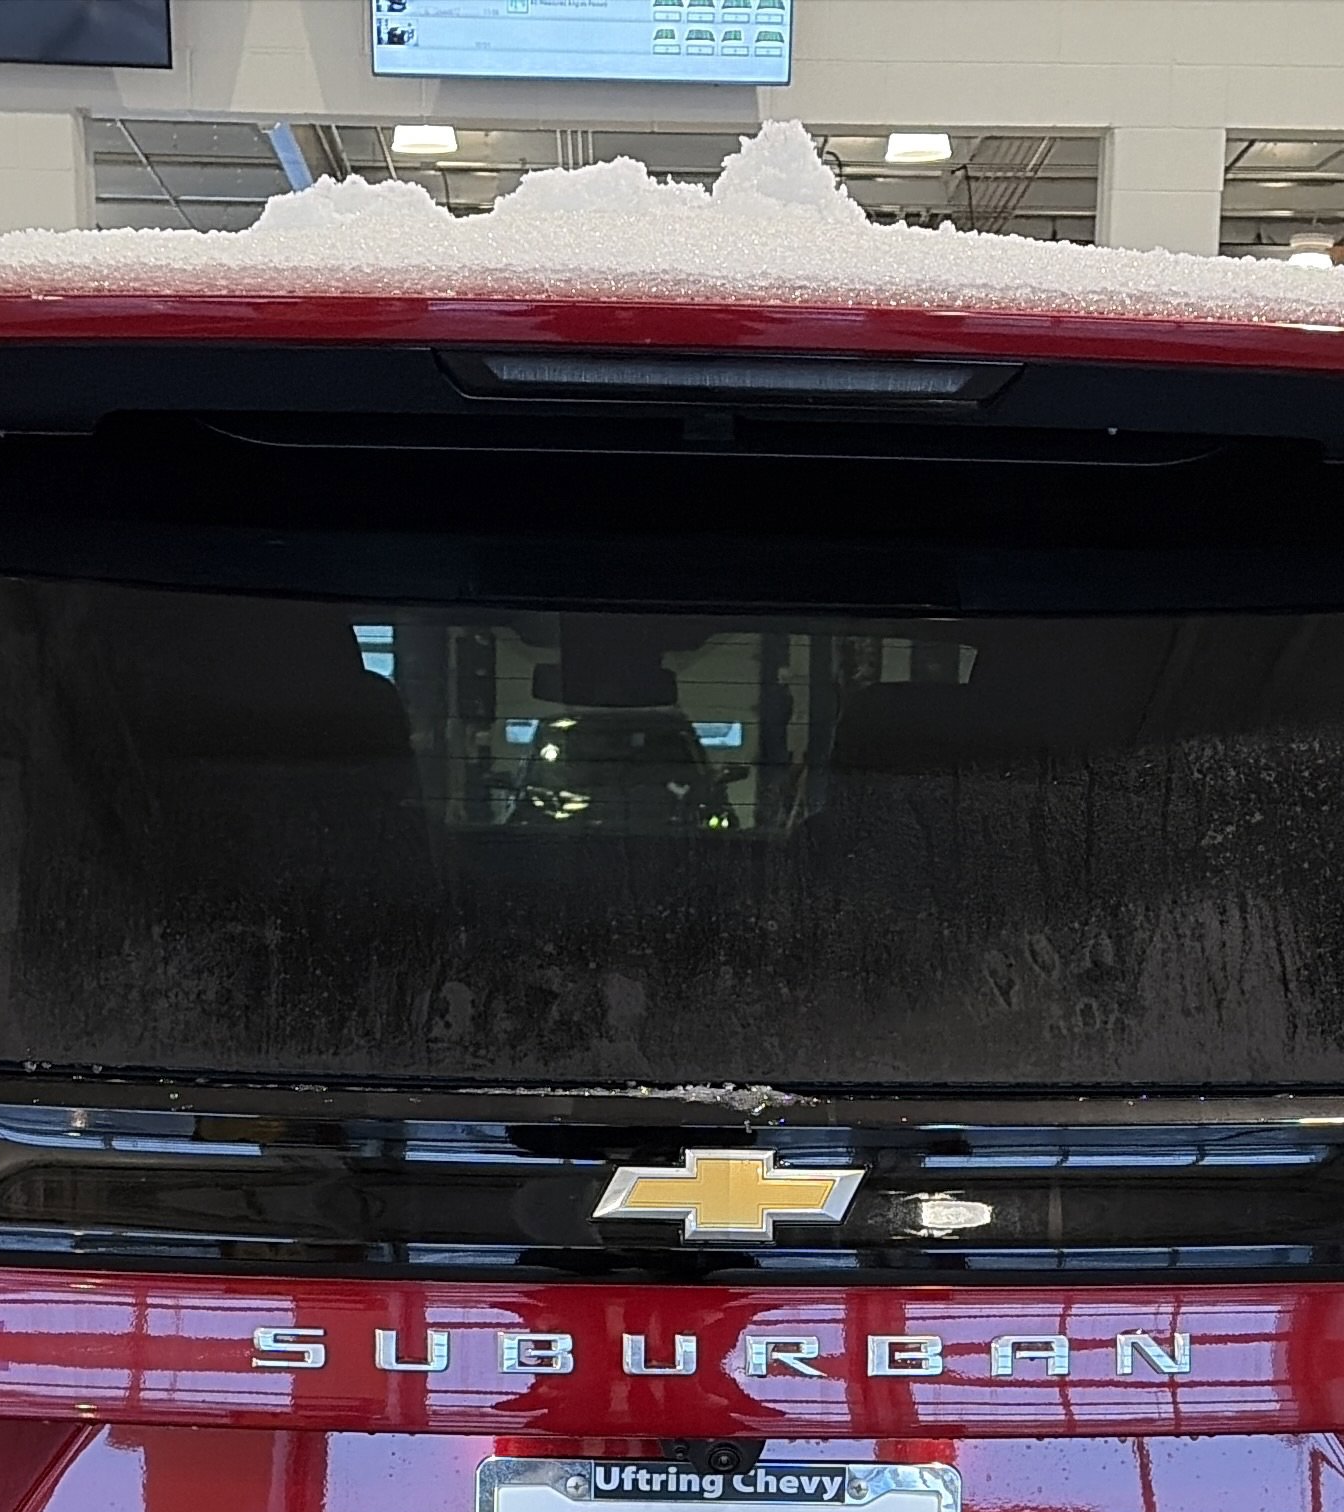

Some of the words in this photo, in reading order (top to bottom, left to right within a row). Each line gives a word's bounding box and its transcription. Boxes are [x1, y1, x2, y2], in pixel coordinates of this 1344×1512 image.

[252, 1326, 1192, 1376] SUBURBAN
[594, 1465, 723, 1499] Uftring
[732, 1467, 844, 1500] Chevy
